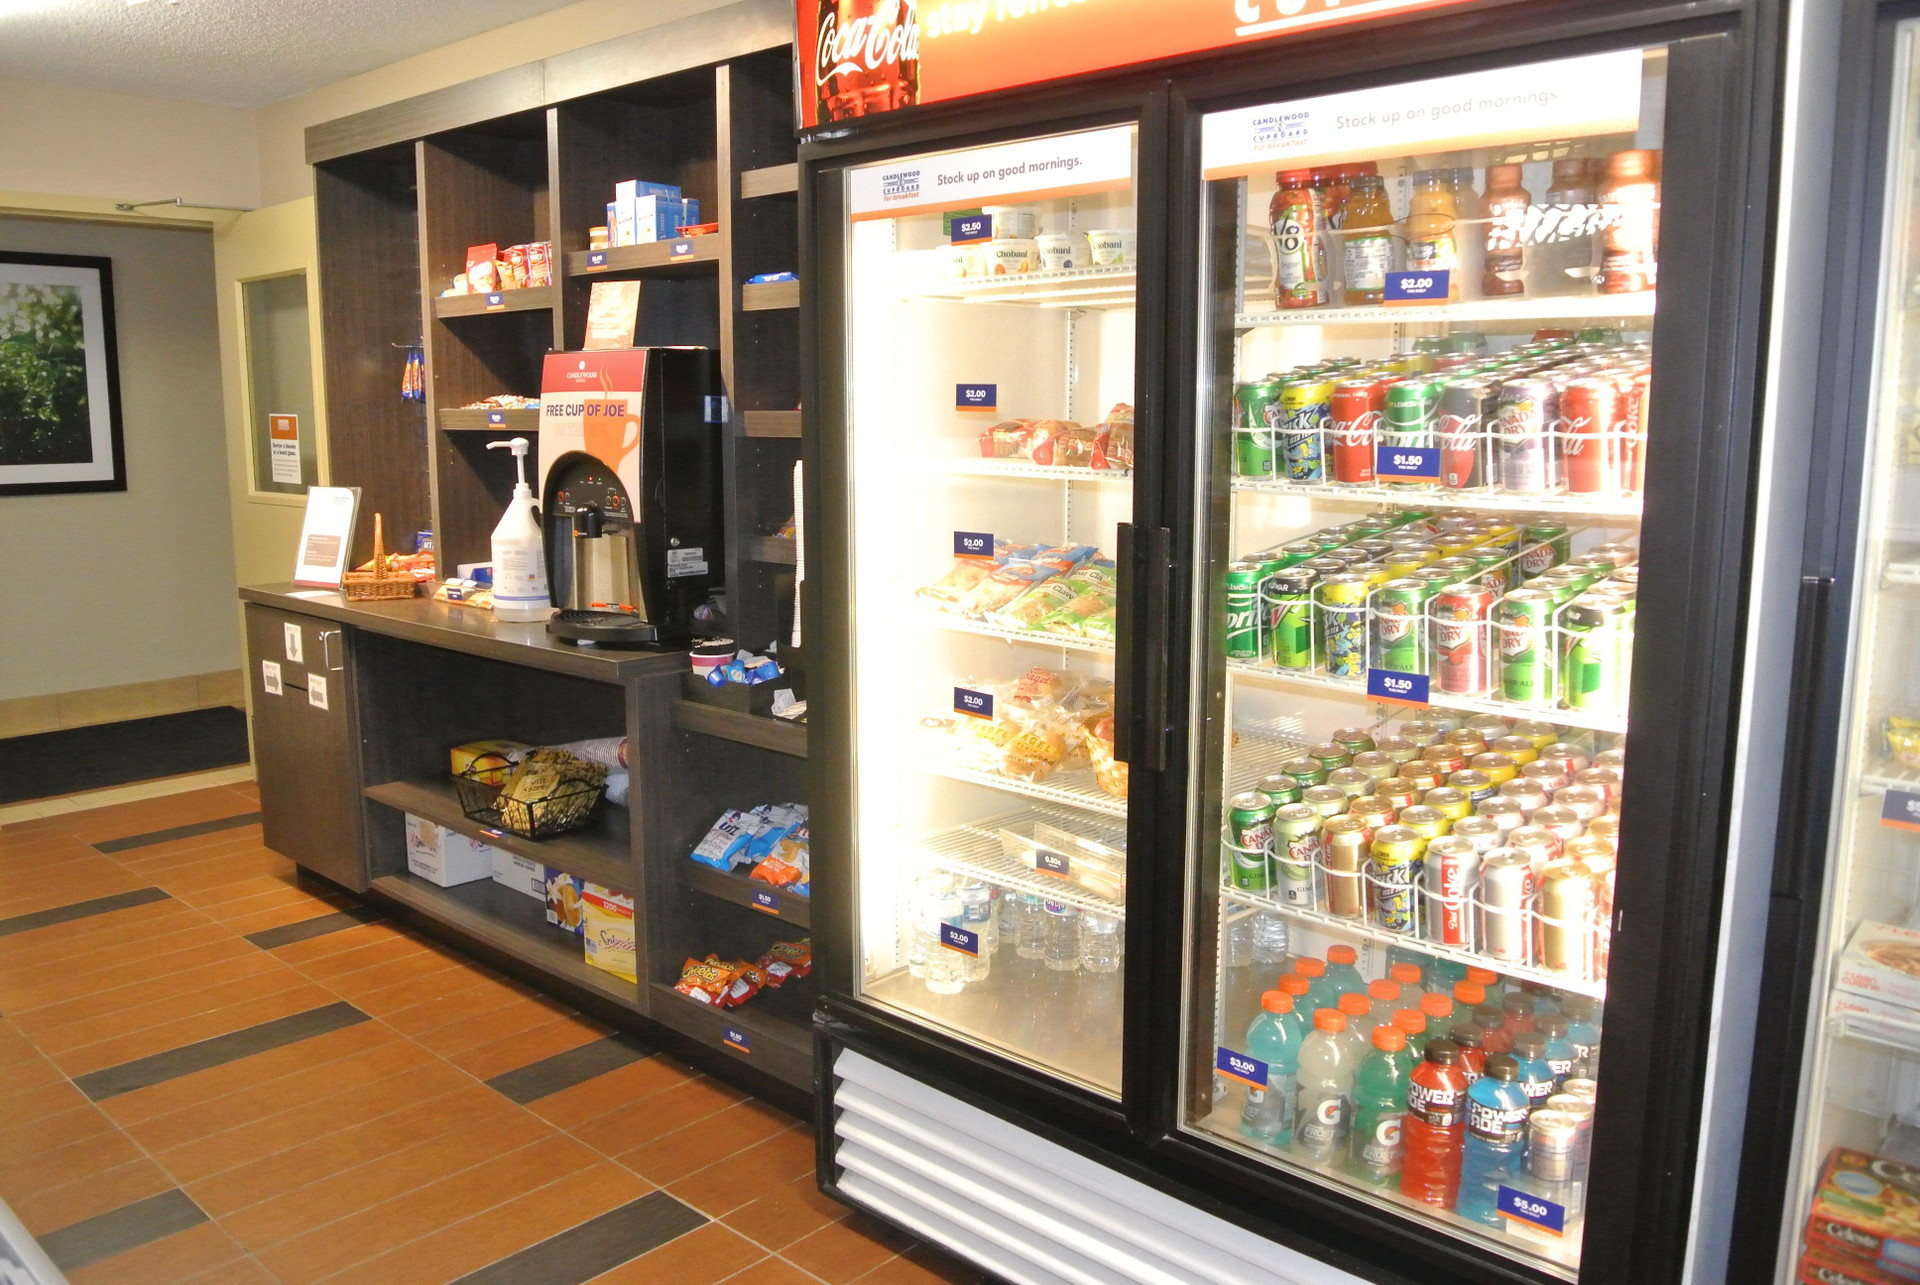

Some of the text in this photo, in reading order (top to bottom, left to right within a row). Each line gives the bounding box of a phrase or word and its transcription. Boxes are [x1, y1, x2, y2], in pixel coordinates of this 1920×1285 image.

[926, 0, 988, 38] stay
[1337, 89, 1562, 130] Stock up on good mornings.
[1252, 112, 1310, 126] CANDLEWOOD
[1253, 128, 1308, 142] CUPBOARD
[1267, 139, 1307, 150] breakfast
[882, 170, 920, 181] CANDLEWOOD
[937, 156, 1083, 186] Stock up on good mornings.
[882, 184, 920, 194] CUPBOARD
[893, 191, 919, 201] breakfast
[961, 221, 982, 233] $2.50
[996, 250, 1028, 259] Chobani
[1401, 278, 1433, 290] $2.00
[966, 389, 987, 399] $2.00
[546, 404, 625, 418] FREE CUP OF JOE
[1393, 454, 1423, 466] $1.50
[963, 537, 984, 548] $2.00
[1089, 571, 1103, 581] Cla
[1052, 584, 1075, 600] Claw
[1440, 630, 1463, 643] DRY
[1383, 677, 1413, 690] $1.50
[963, 694, 984, 707] $2.00
[1020, 733, 1052, 754] AGEL
[603, 900, 618, 913] 1200
[949, 931, 969, 944] $2.00
[682, 965, 720, 983] Cheetos
[1229, 1057, 1255, 1073] $3.00
[1519, 1081, 1554, 1098] WER
[1317, 1098, 1343, 1126] G
[1471, 1101, 1529, 1124] POWER
[1470, 1114, 1505, 1136] ADE
[1376, 1119, 1402, 1147] G
[1513, 1197, 1548, 1217] $5.00
